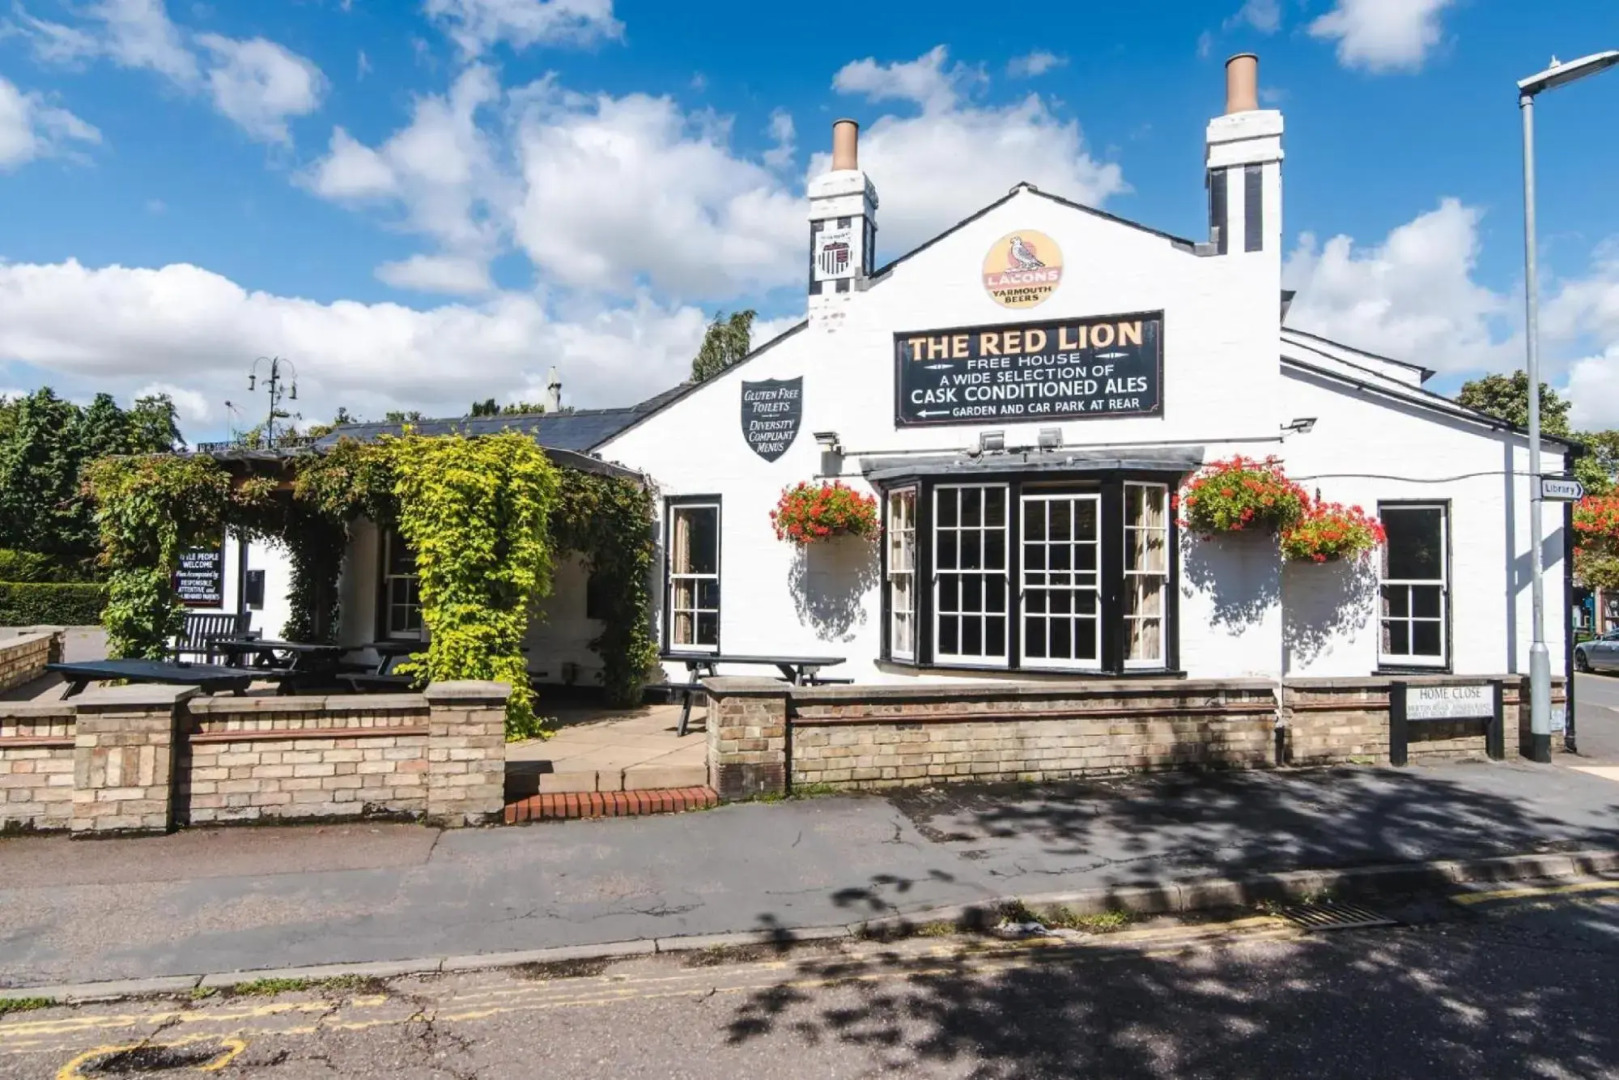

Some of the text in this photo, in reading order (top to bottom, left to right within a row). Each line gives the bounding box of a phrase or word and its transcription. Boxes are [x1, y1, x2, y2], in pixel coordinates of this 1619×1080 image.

[988, 270, 1059, 286] LACONS
[993, 286, 1052, 297] YARMOUTH
[1005, 294, 1039, 303] BEERS
[908, 321, 1143, 361] THE RED LION
[967, 352, 1081, 370] FREE HOUSE
[939, 364, 1115, 387] A WIDE SELECTION OF
[744, 387, 800, 401] GLUTEN FREE
[911, 376, 1148, 404] CASK CONDITIONED ALES
[752, 401, 791, 413] TOILETS
[952, 397, 1140, 417] GARDEN AND CAR PARK AT REAR
[749, 419, 796, 431] DIVERSITY
[748, 430, 796, 442] COMPLIANT
[757, 442, 785, 453] MENUS
[1545, 483, 1574, 495] Library
[197, 553, 219, 561] PEOPLE
[182, 560, 213, 568] WELCOME
[1420, 686, 1481, 700] HOME CLOSE
